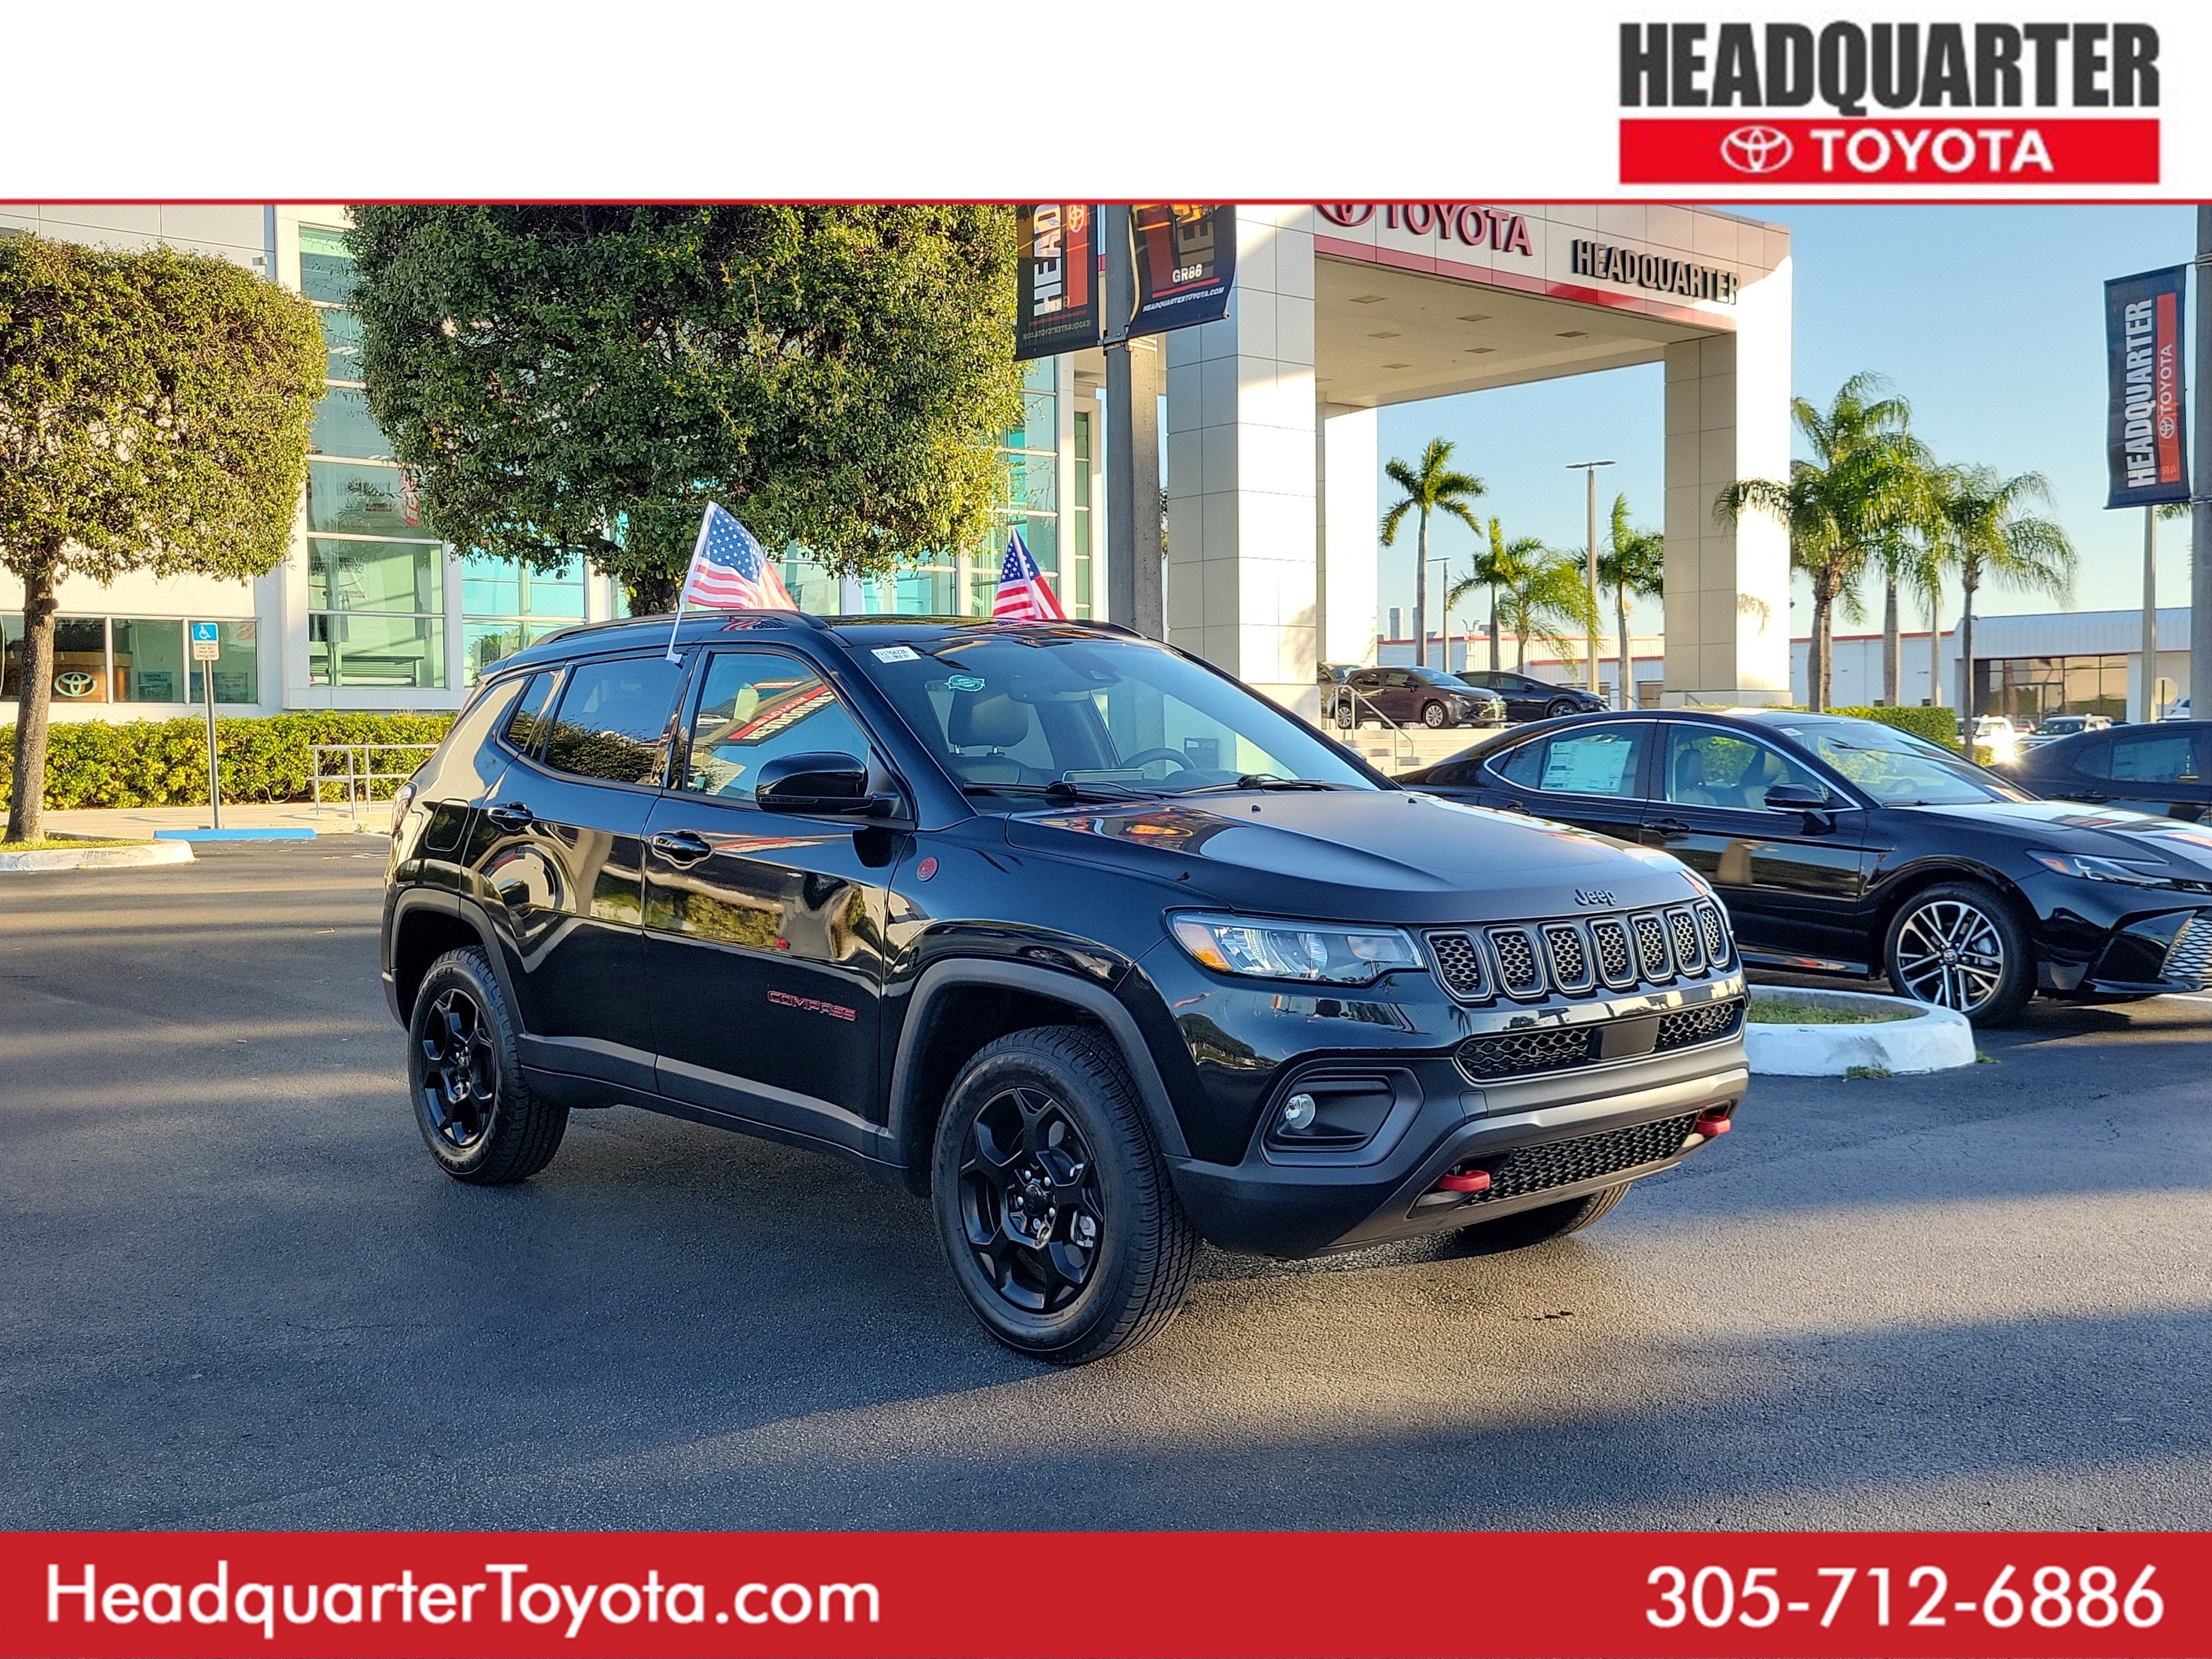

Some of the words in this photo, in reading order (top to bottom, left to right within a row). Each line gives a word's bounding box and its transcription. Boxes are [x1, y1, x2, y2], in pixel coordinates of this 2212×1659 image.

[1172, 263, 1203, 283] GR86
[1571, 239, 1741, 305] HEADQUARTER
[1142, 287, 1225, 312] HEADQUARTERTOYOTA.COM
[2125, 299, 2157, 488] HEADQUARTER
[2159, 343, 2173, 416] TOYOTA
[1574, 888, 1617, 907] Jeep
[768, 990, 857, 1022] COMPASS
